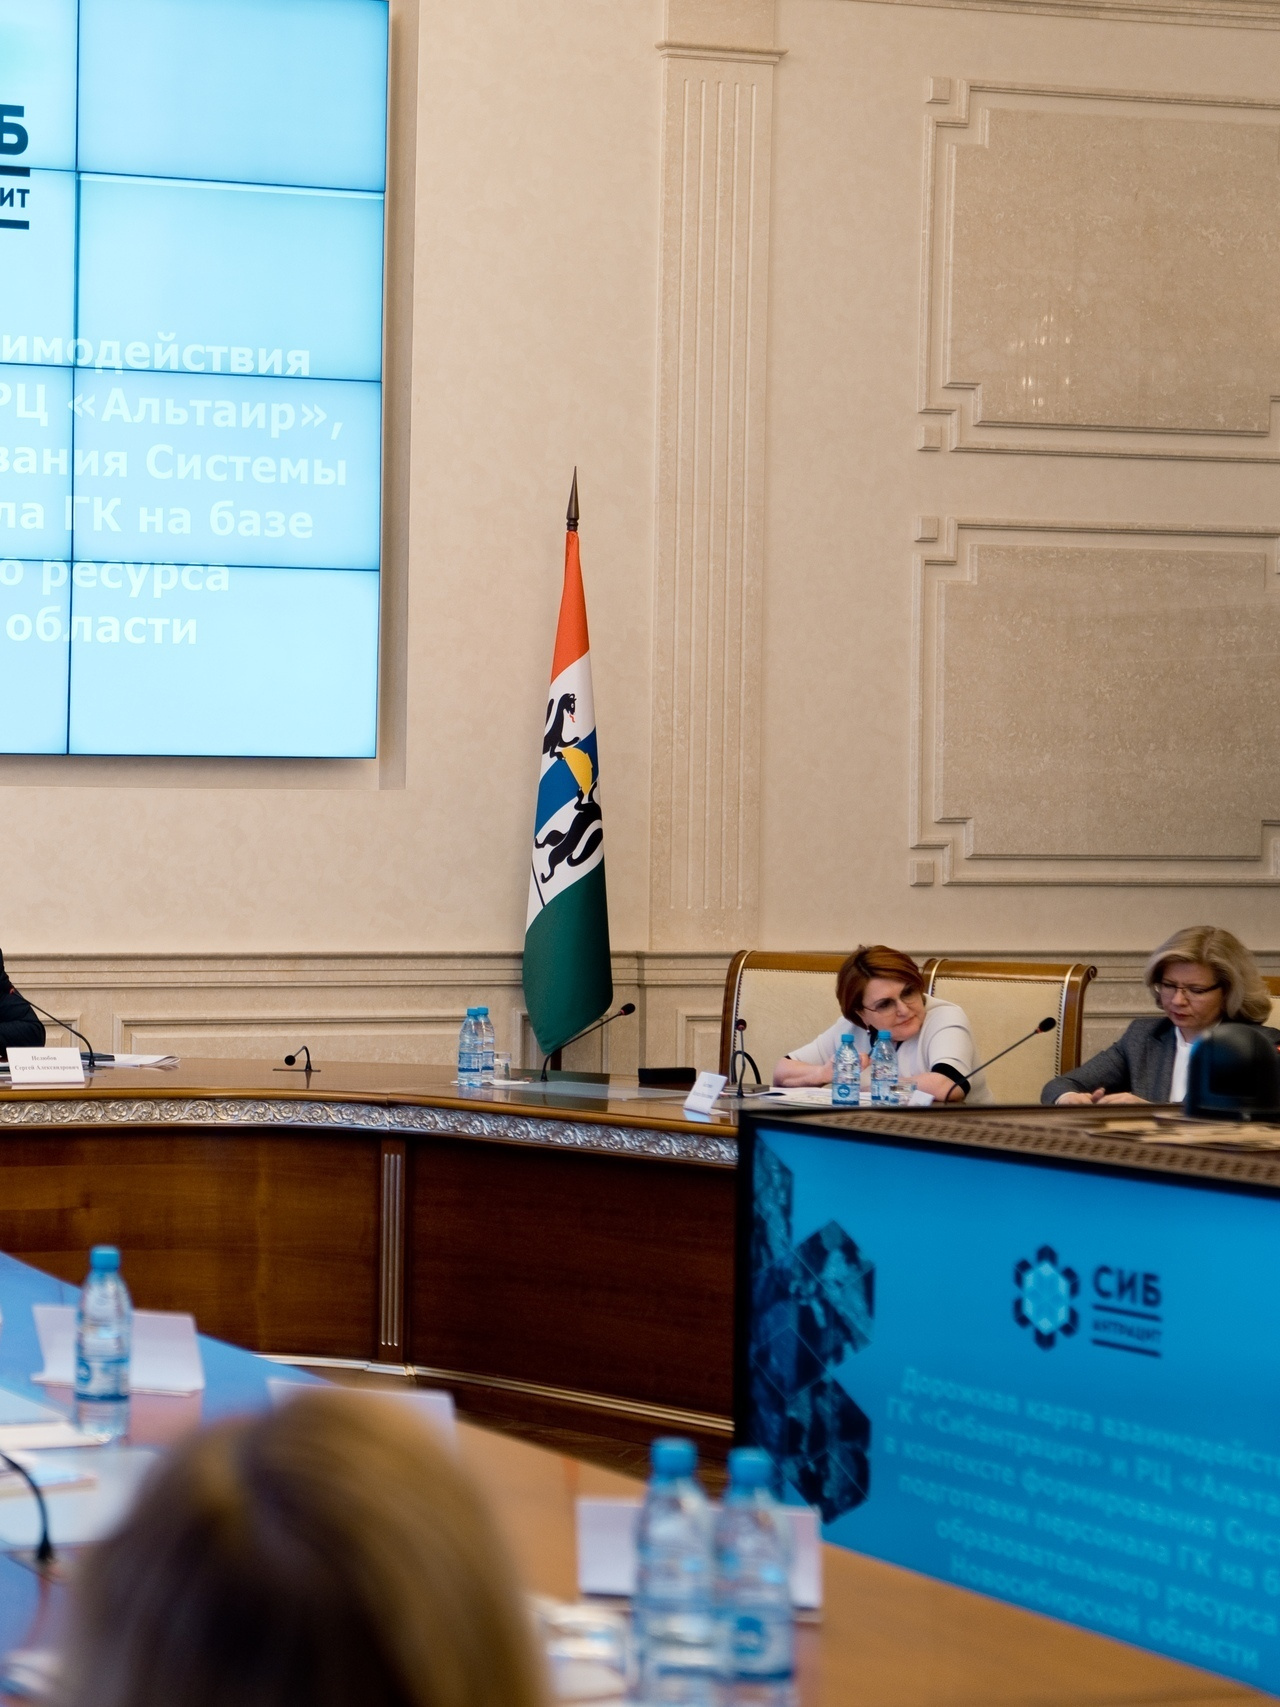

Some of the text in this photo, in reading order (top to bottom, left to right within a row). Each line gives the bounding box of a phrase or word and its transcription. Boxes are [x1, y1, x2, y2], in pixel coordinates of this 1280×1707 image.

[67, 387, 344, 440] «Альтаир»,
[146, 445, 346, 486] Системы
[65, 495, 122, 533] ГК
[139, 506, 191, 534] на
[210, 501, 314, 539] базе
[42, 559, 230, 598] ресурса
[6, 606, 197, 645] области
[1093, 1265, 1162, 1307] СИБ
[901, 1365, 1019, 1414] Дорожная
[1025, 1400, 1094, 1432] карта
[886, 1396, 913, 1424] ГК
[1134, 1456, 1172, 1494] РЦ
[903, 1440, 1016, 1486] контексте
[1021, 1466, 1216, 1540] формирования
[898, 1474, 1029, 1525] подготовки
[1035, 1511, 1170, 1565] персонала
[1177, 1543, 1212, 1577] ГК
[1220, 1562, 1254, 1590] на
[935, 1518, 1277, 1637] образовательного ресурса
[1146, 1616, 1259, 1671] области
